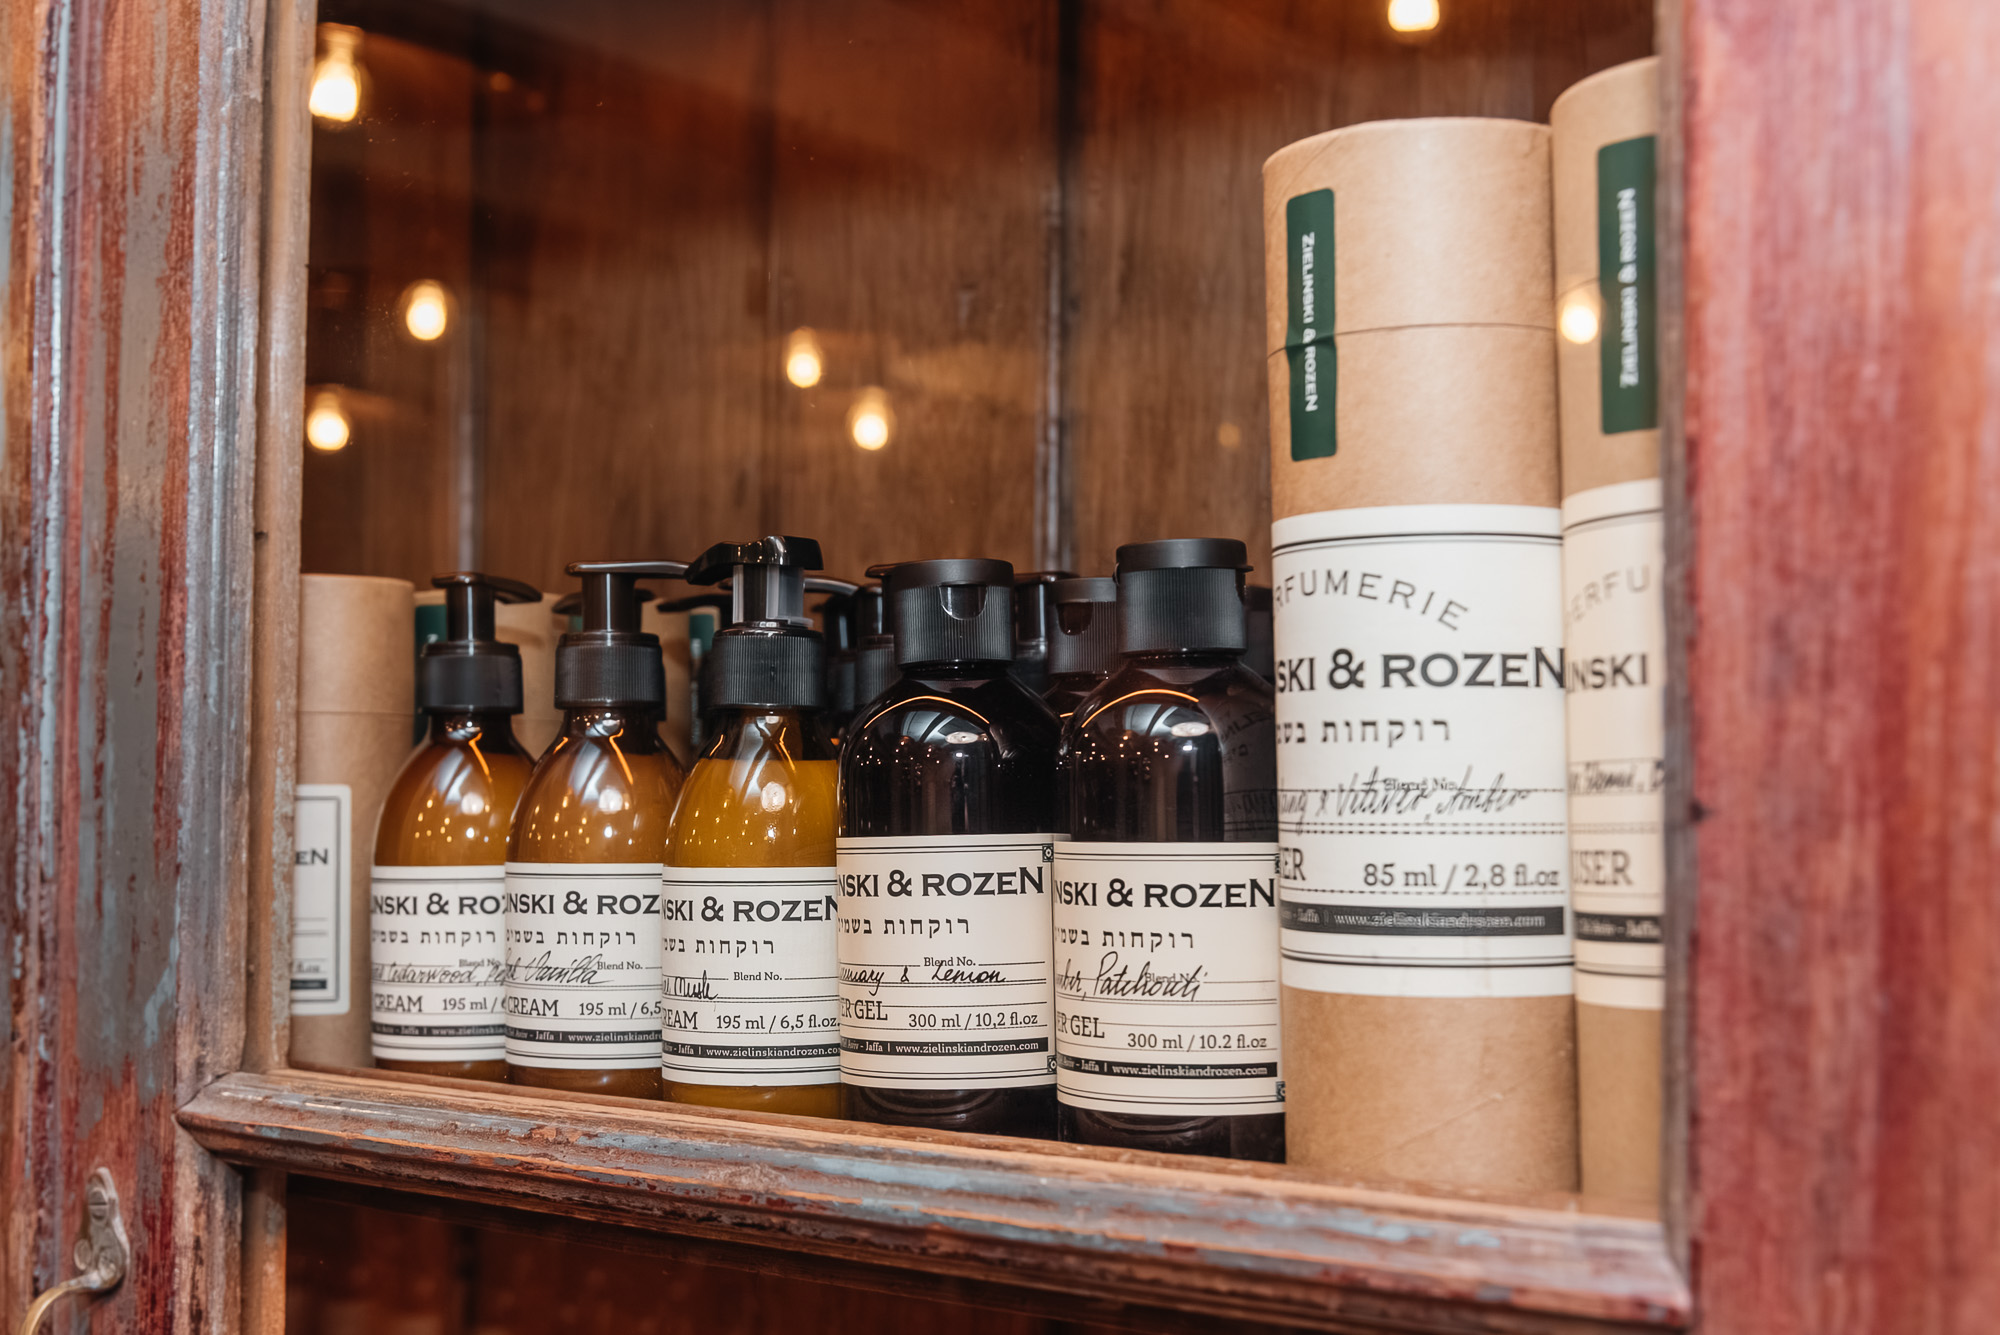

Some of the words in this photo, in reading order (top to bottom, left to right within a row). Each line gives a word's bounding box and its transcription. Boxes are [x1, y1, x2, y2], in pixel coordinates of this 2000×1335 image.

[1301, 231, 1316, 324] ZIELINSKI
[1304, 346, 1319, 413] ROZEN
[1328, 648, 1365, 690] &
[1381, 646, 1567, 689] ROZEN
[1322, 718, 1450, 748] רוקחות
[887, 869, 913, 897] &
[921, 866, 1045, 897] ROZEN
[1364, 863, 1395, 887] 85
[1403, 863, 1438, 887] ml
[1464, 863, 1506, 891] 2,8
[562, 890, 588, 915] &
[1106, 877, 1134, 907] &
[1144, 878, 1275, 908] ROZEN
[426, 892, 450, 915] &
[700, 895, 724, 922] &
[884, 917, 970, 939] רוקחות
[420, 930, 497, 948] רוקחות
[556, 930, 636, 948] רוקחות
[695, 938, 775, 958] רוקחות
[1101, 930, 1194, 953] רוקחות
[596, 961, 624, 971] Blend
[627, 961, 644, 971] No.
[923, 957, 954, 968] Blend
[957, 957, 977, 968] No.
[733, 971, 761, 982] Blend
[764, 972, 783, 982] No.
[442, 998, 466, 1011] 195
[469, 997, 488, 1011] ml
[507, 996, 559, 1017] CREAM
[578, 1002, 604, 1016] 195
[608, 1002, 627, 1016] ml
[854, 999, 888, 1021] GEL
[716, 1014, 742, 1030] 195
[745, 1015, 766, 1030] ml
[780, 1014, 804, 1031] 6,5
[908, 1013, 937, 1028] 300
[941, 1013, 962, 1028] ml
[975, 1012, 1006, 1030] 10,2
[1009, 1010, 1039, 1027] fl.oz
[1070, 1014, 1105, 1038] GEL
[535, 1030, 555, 1041] Jaffa
[1127, 1033, 1158, 1048] 300
[1161, 1034, 1184, 1049] ml
[1199, 1034, 1233, 1049] 10.2
[1236, 1033, 1269, 1049] fl.oz
[678, 1043, 694, 1056] Jaffa
[865, 1041, 884, 1052] Jaffa
[895, 1041, 1040, 1055] www.zielinskiandrozen.com
[1081, 1060, 1100, 1073] Jaffa
[1112, 1062, 1269, 1077] www.zielinskiandrozen.com
